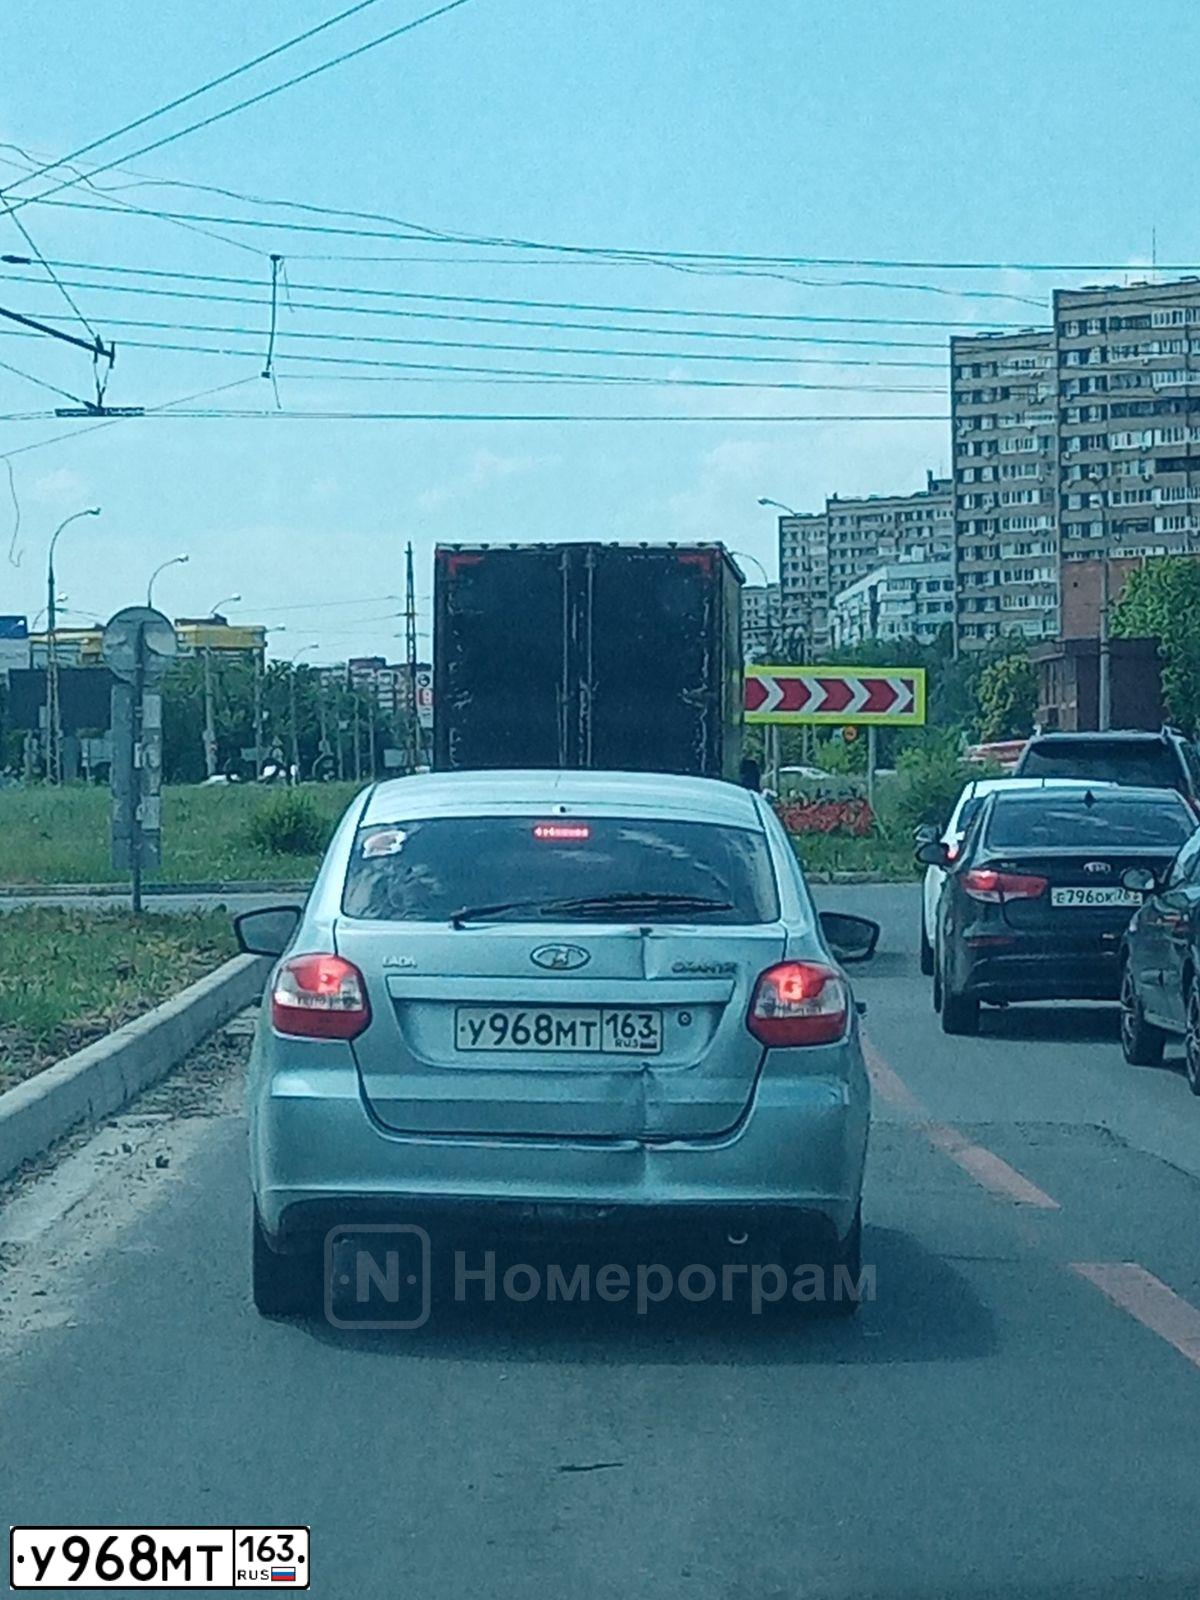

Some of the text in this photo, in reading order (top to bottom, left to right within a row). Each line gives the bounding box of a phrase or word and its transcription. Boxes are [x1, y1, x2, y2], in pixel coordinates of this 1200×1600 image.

[467, 1013, 653, 1047] У968МТ 163
[615, 1039, 638, 1048] RUS
